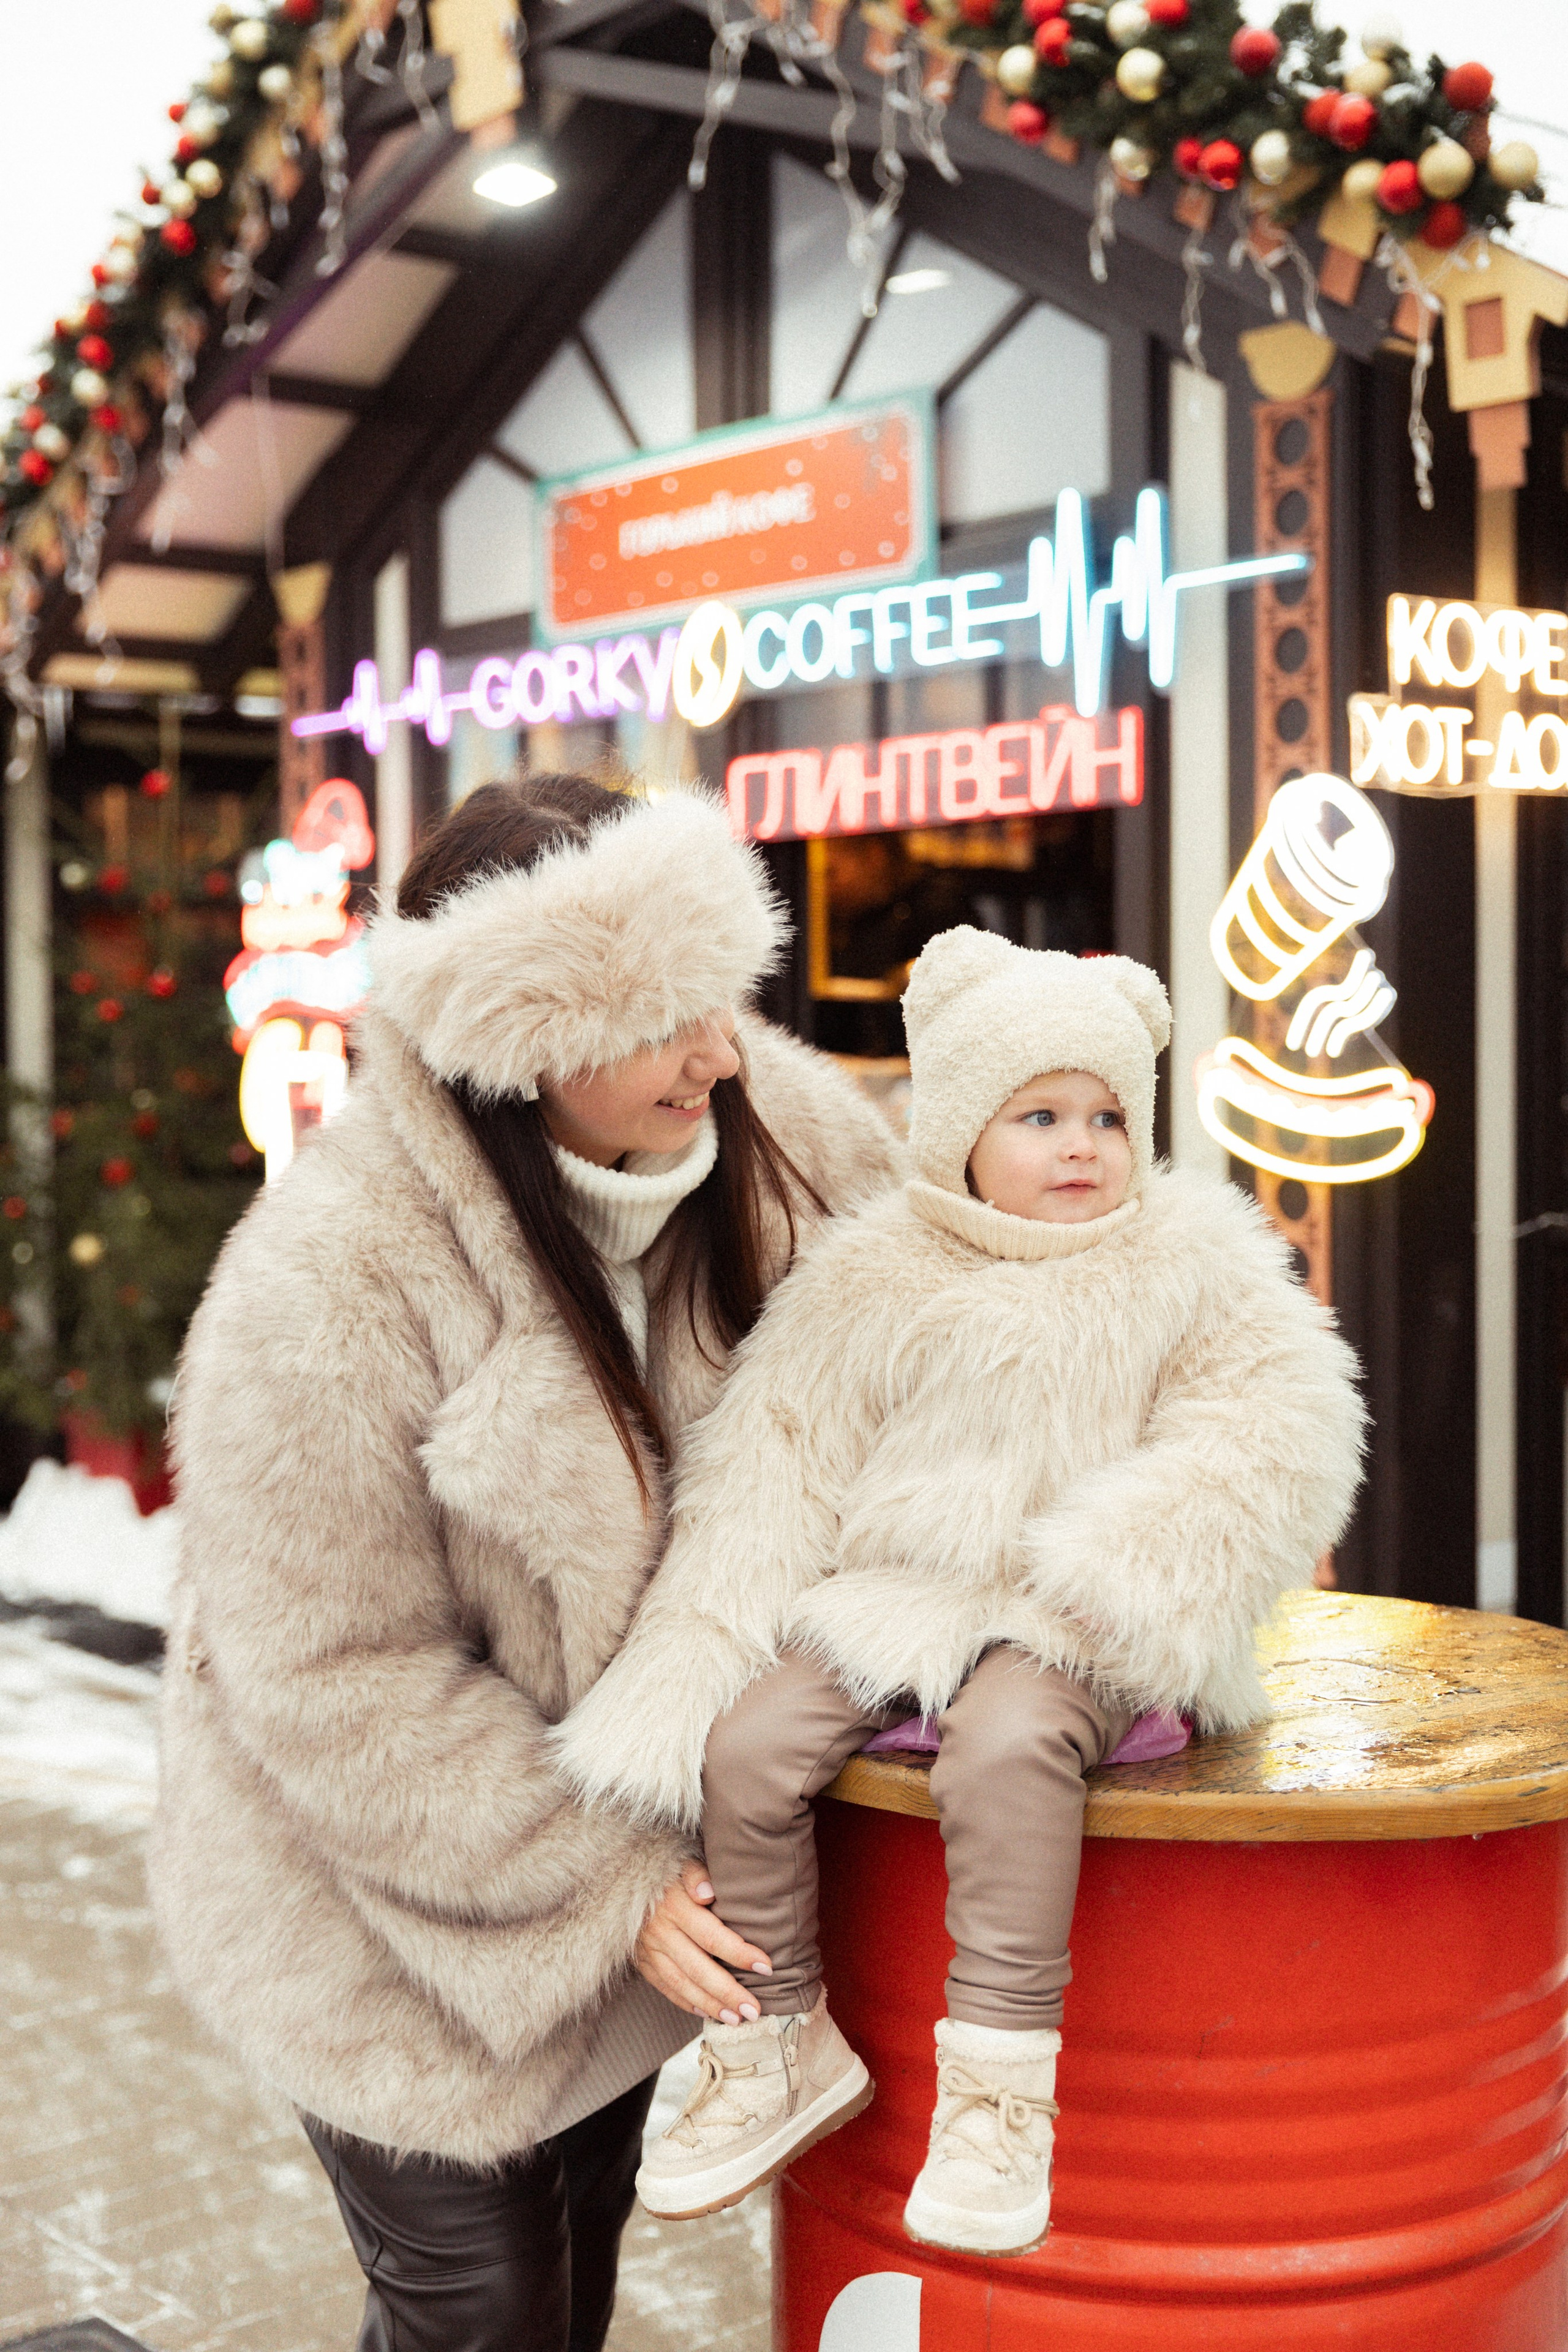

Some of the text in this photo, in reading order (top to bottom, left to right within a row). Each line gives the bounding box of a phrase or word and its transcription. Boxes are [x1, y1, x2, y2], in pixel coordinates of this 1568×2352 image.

[470, 572, 1003, 729] GORKY COFFEE
[1392, 595, 1568, 696] КОФЕ
[727, 704, 1144, 841] ГЛИНТВЕЙН
